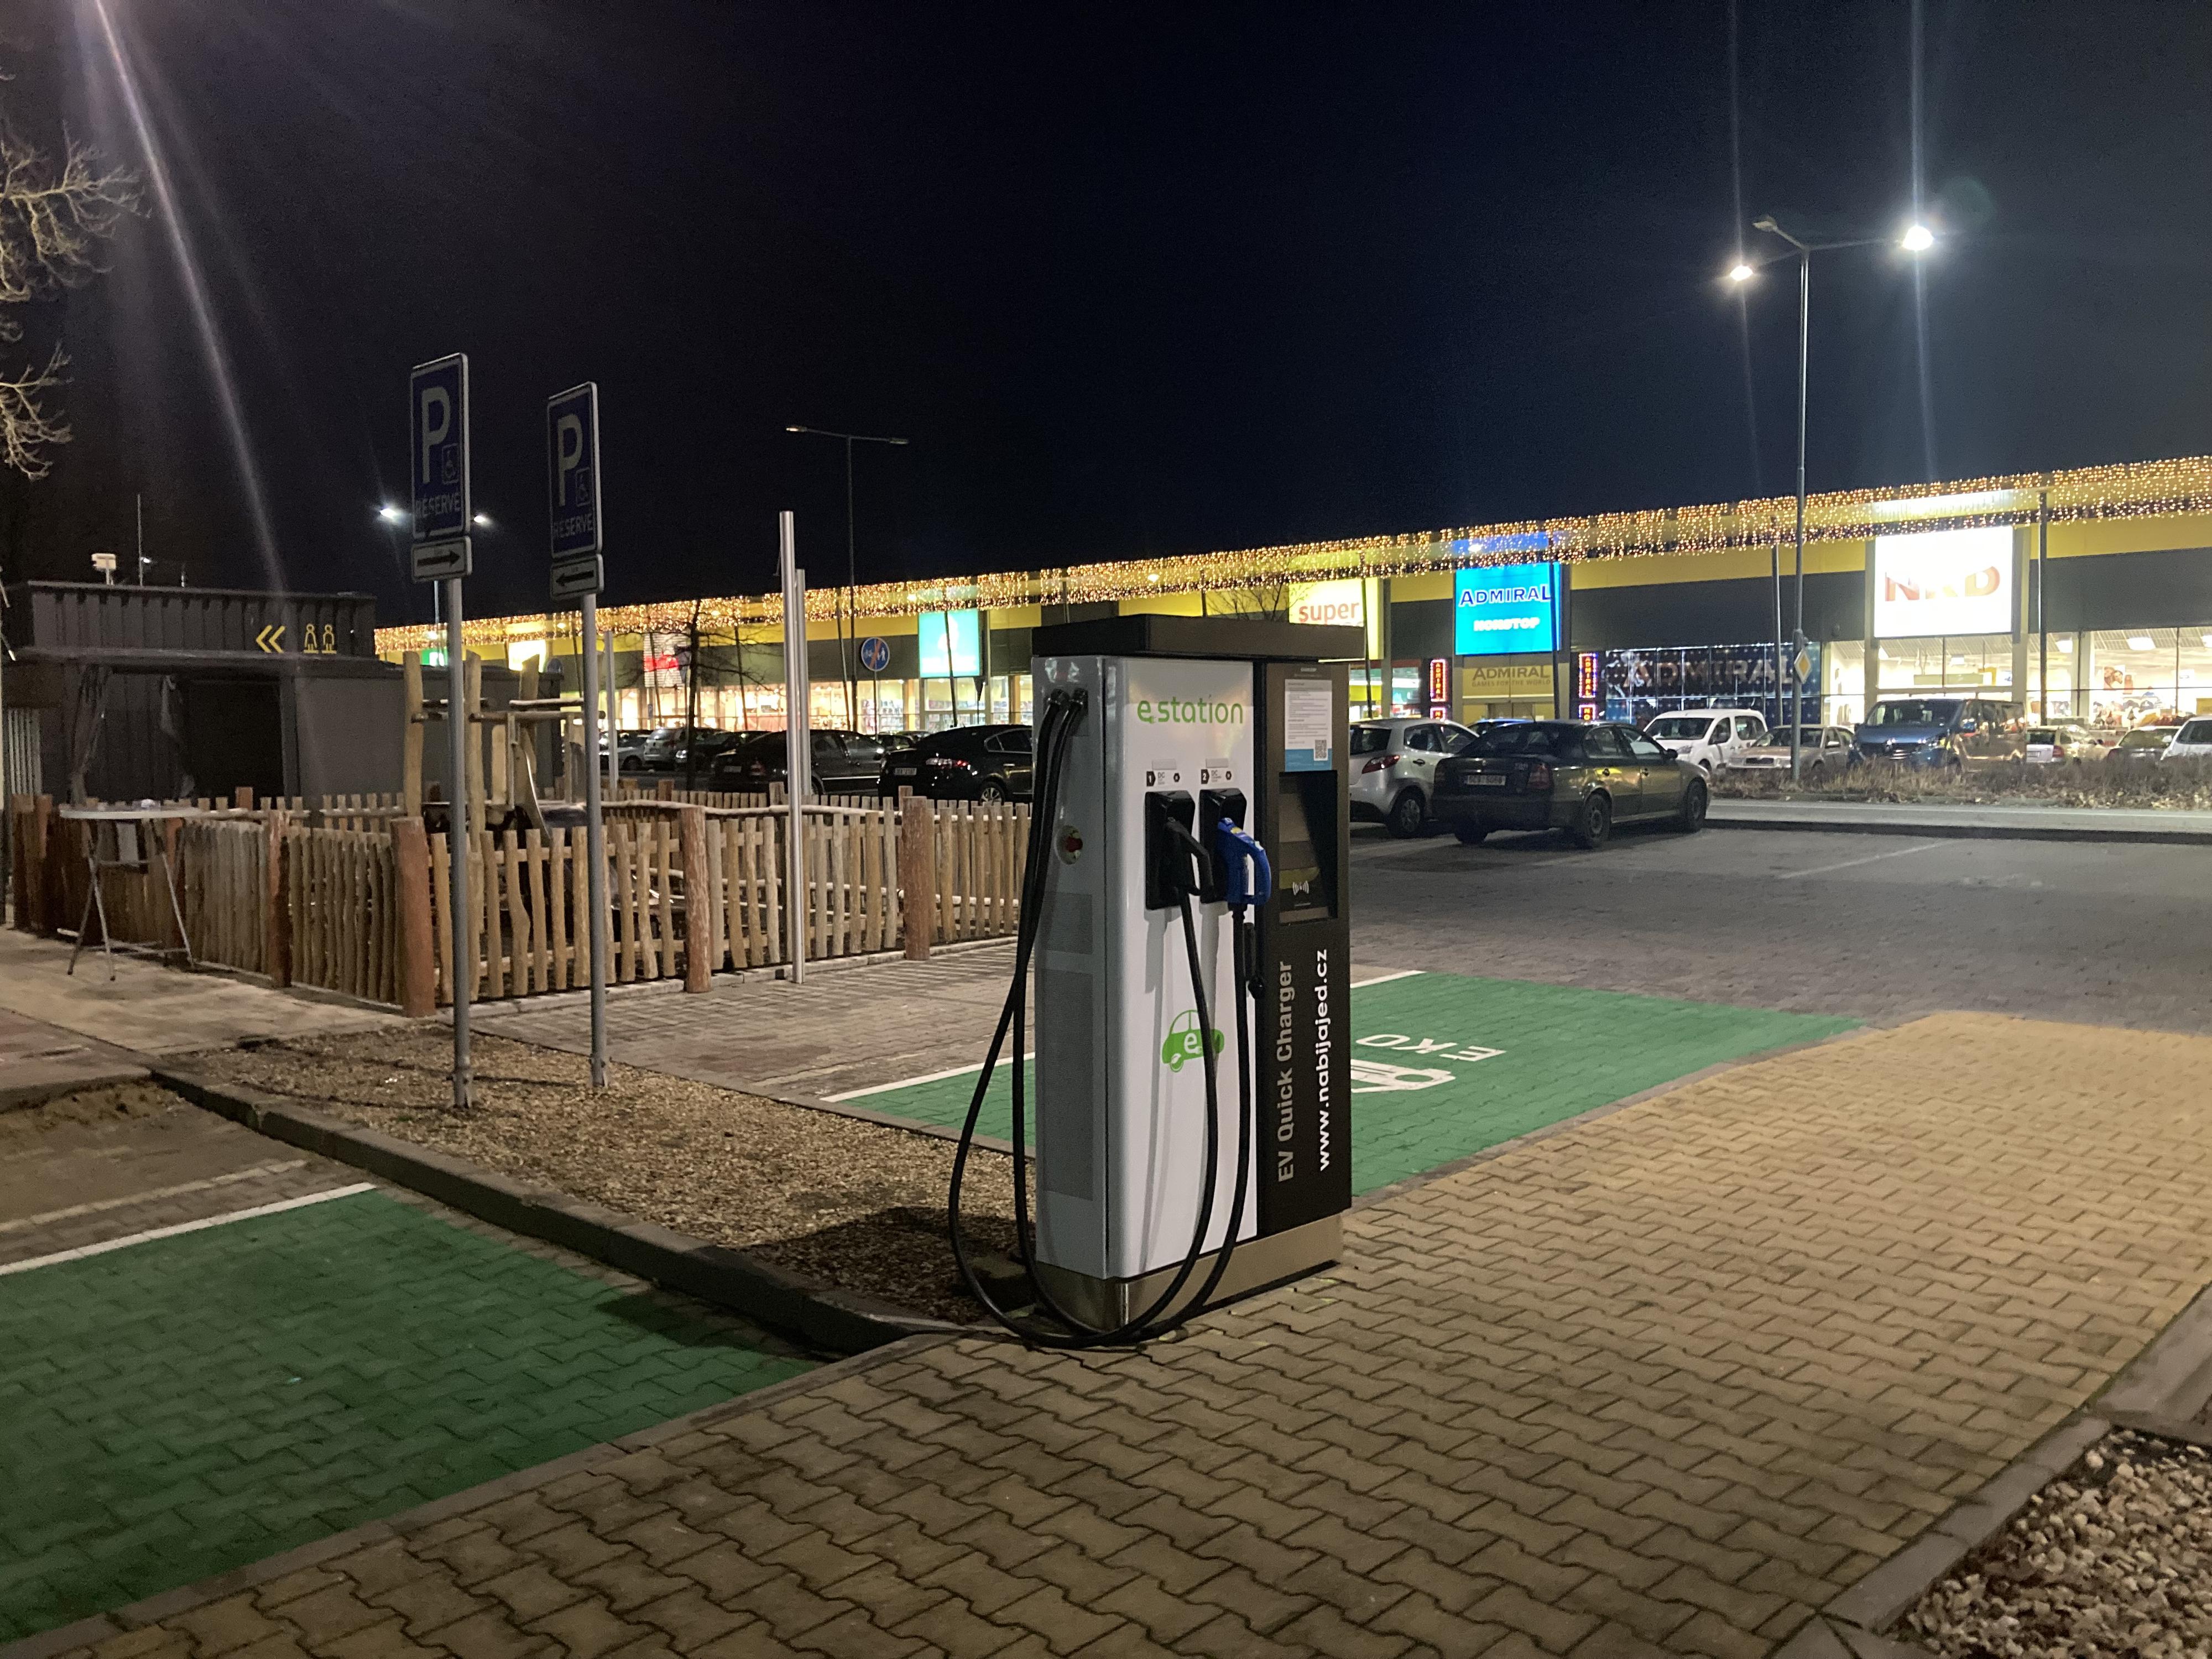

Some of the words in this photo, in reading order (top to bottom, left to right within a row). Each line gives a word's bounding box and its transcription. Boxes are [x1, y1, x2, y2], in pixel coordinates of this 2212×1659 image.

[421, 387, 451, 484] P
[557, 413, 583, 507] P
[1459, 584, 1551, 607] ADMIRAL
[1298, 602, 1359, 625] super
[1472, 665, 1551, 681] ADMIRAL
[1623, 655, 1793, 688] ADMIRAL
[1203, 773, 1207, 781] 2
[1276, 961, 1295, 1062] Charger
[1314, 949, 1330, 1171] www.nabijajed.cz
[1355, 1034, 1507, 1062] EKO
[1277, 1067, 1295, 1142] Quick
[1278, 1151, 1294, 1182] EV
